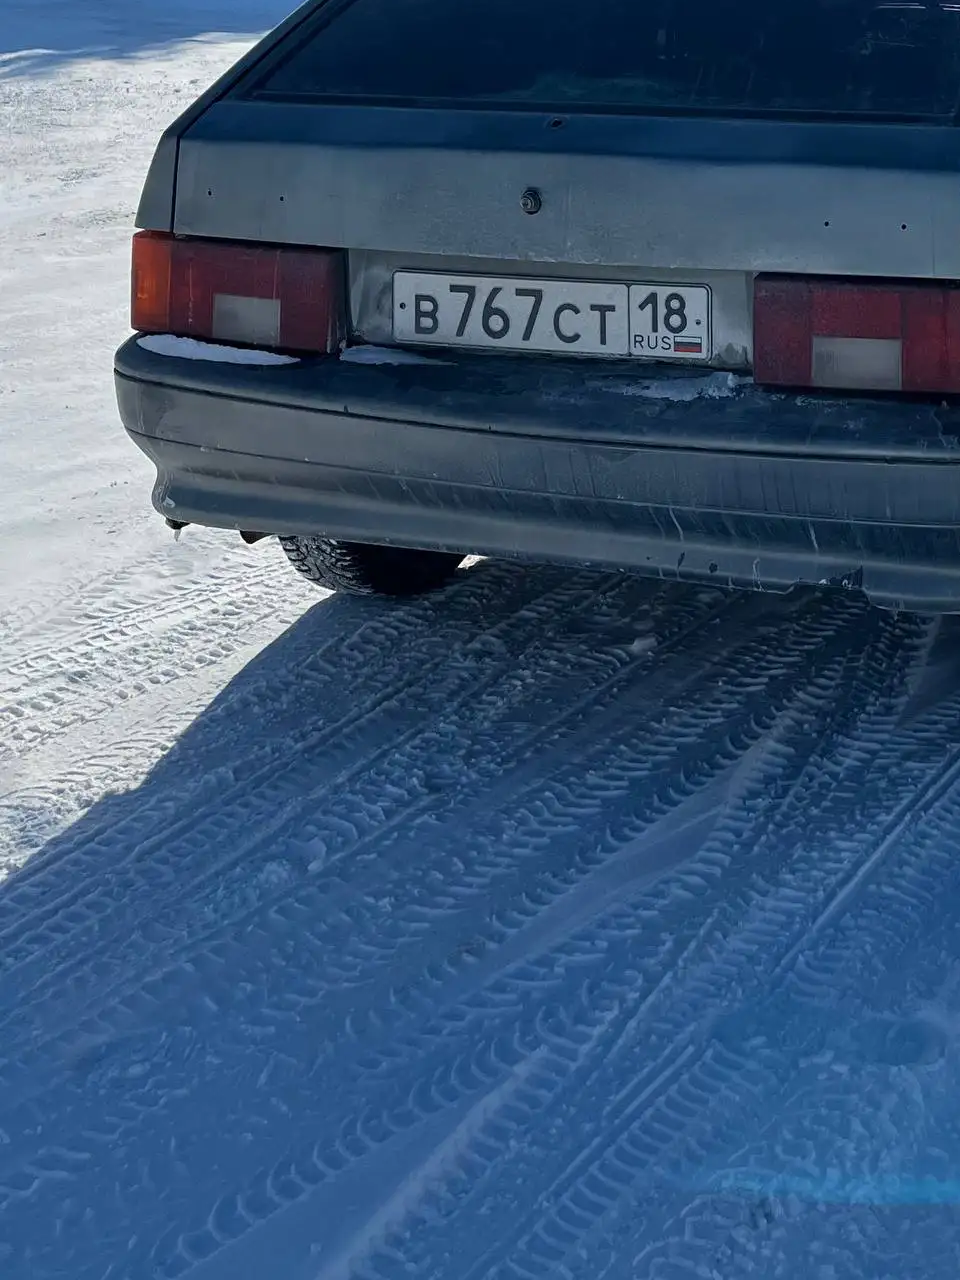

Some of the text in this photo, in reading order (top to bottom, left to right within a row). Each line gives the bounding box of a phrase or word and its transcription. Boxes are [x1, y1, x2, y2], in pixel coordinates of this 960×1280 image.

[414, 284, 688, 346] В767СТ 18
[633, 334, 671, 351] RUS
